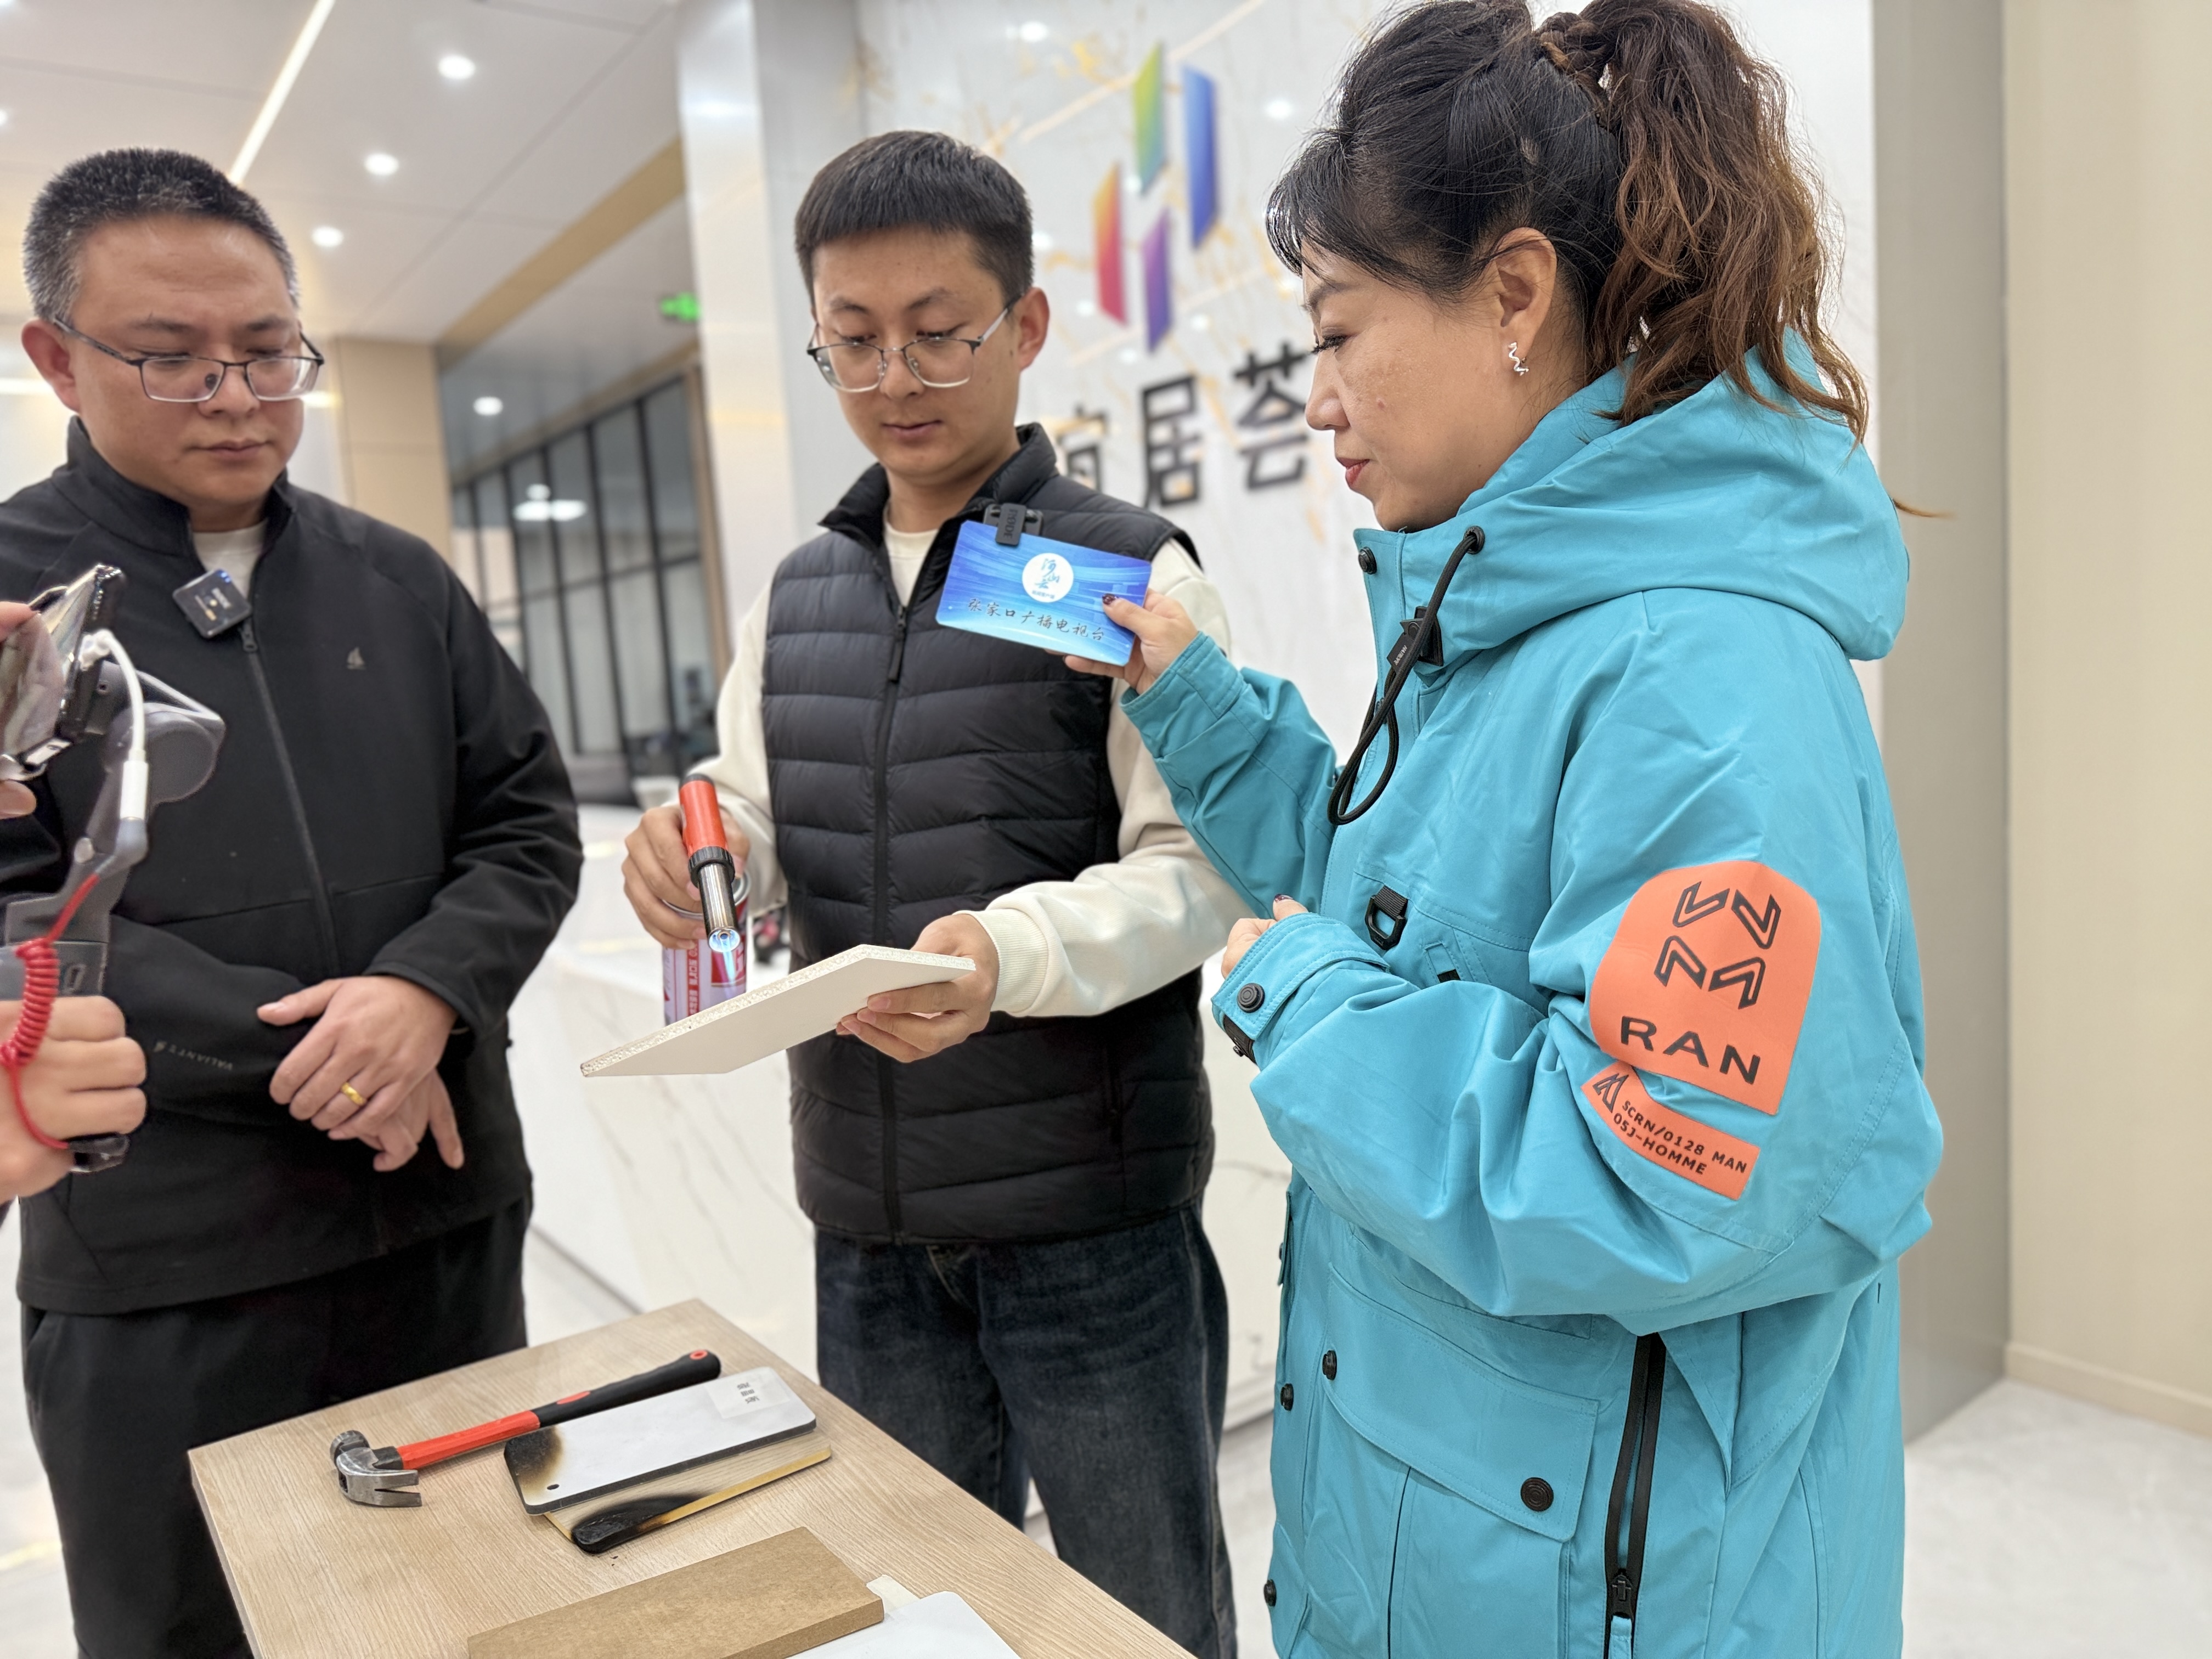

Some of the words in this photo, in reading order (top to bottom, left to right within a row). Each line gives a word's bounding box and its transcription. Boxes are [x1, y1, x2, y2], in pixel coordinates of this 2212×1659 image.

[968, 598, 1104, 641] 张家口广播电视台
[1621, 1015, 1761, 1086] RAN
[1613, 1113, 1707, 1175] 05J-HOMME
[1622, 1100, 1705, 1155] SCRN/0128
[1712, 1151, 1747, 1173] MAN
